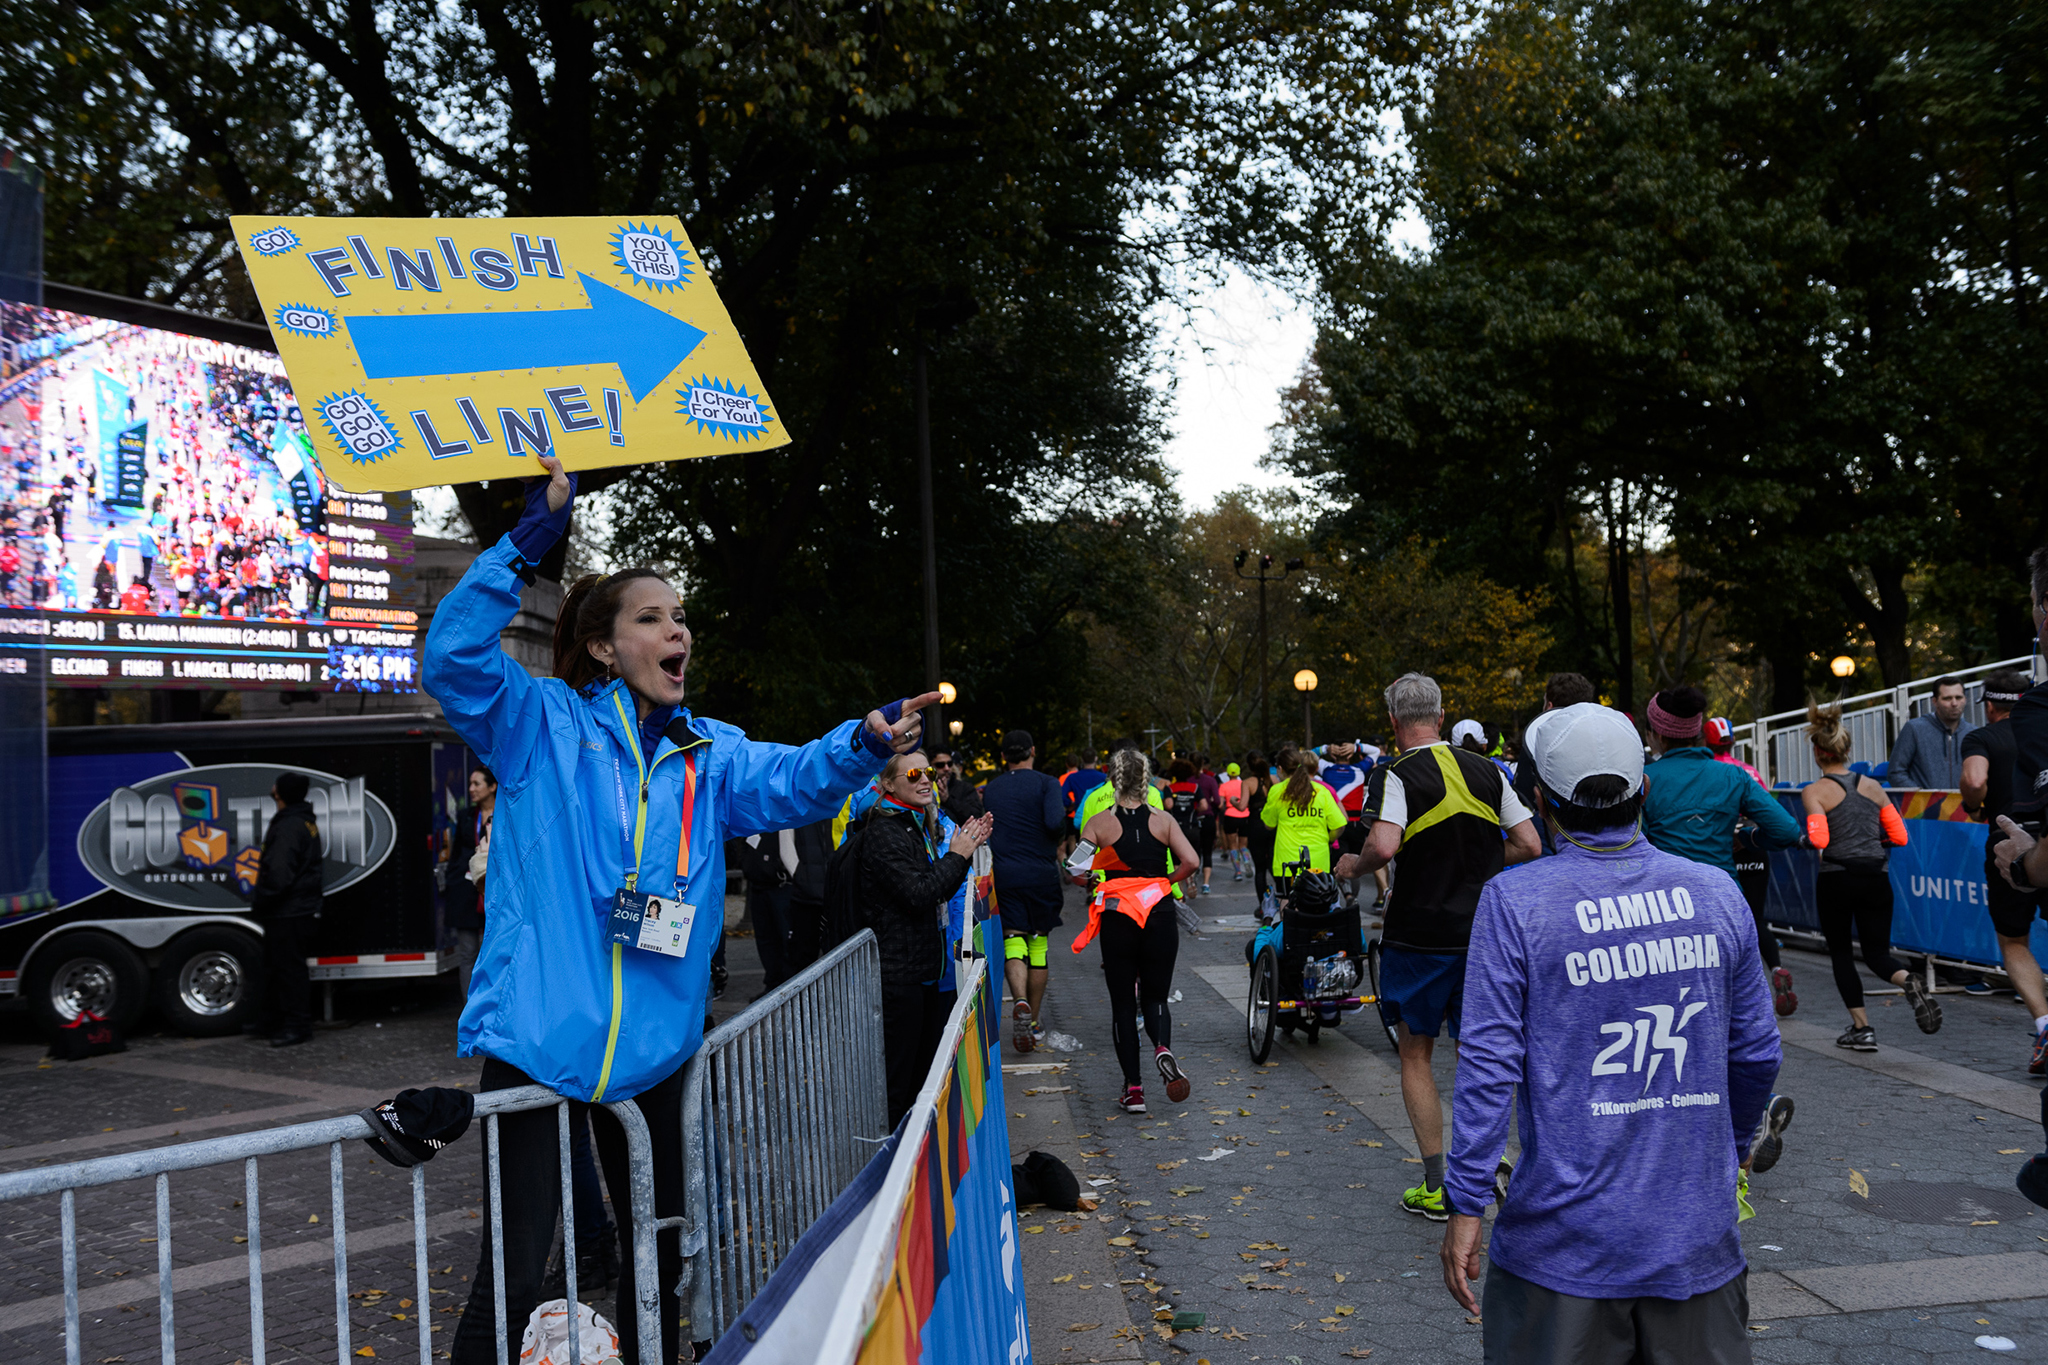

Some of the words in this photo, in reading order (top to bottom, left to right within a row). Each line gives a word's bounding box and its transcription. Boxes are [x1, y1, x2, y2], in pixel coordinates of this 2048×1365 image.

[255, 231, 293, 252] GO!
[628, 236, 666, 252] YOU
[306, 232, 565, 298] FINISH
[632, 249, 669, 263] GOT
[631, 260, 676, 276] THIS!
[286, 312, 326, 330] GO!
[327, 396, 366, 420] GO!
[694, 390, 700, 403] I
[703, 392, 752, 410] Cheer
[409, 385, 625, 460] LINE!
[691, 403, 720, 418] For
[721, 407, 759, 424] You!
[340, 413, 379, 436] GO!
[353, 429, 392, 453] GO!
[136, 623, 179, 642] LAURA
[121, 659, 164, 677] FINISH
[183, 660, 230, 678] MARCEL
[231, 662, 257, 679] HUG
[341, 654, 380, 681] 3:16
[382, 656, 412, 681] PM
[1287, 807, 1324, 818] GUIDE
[621, 811, 630, 842] MARATHON
[144, 873, 205, 883] OUTDOOR
[211, 873, 228, 883] TV
[614, 908, 640, 922] 2016
[1575, 886, 1695, 934] CAMILO
[1565, 934, 1720, 987] COLOMBIA
[1672, 1092, 1720, 1108] Colombia
